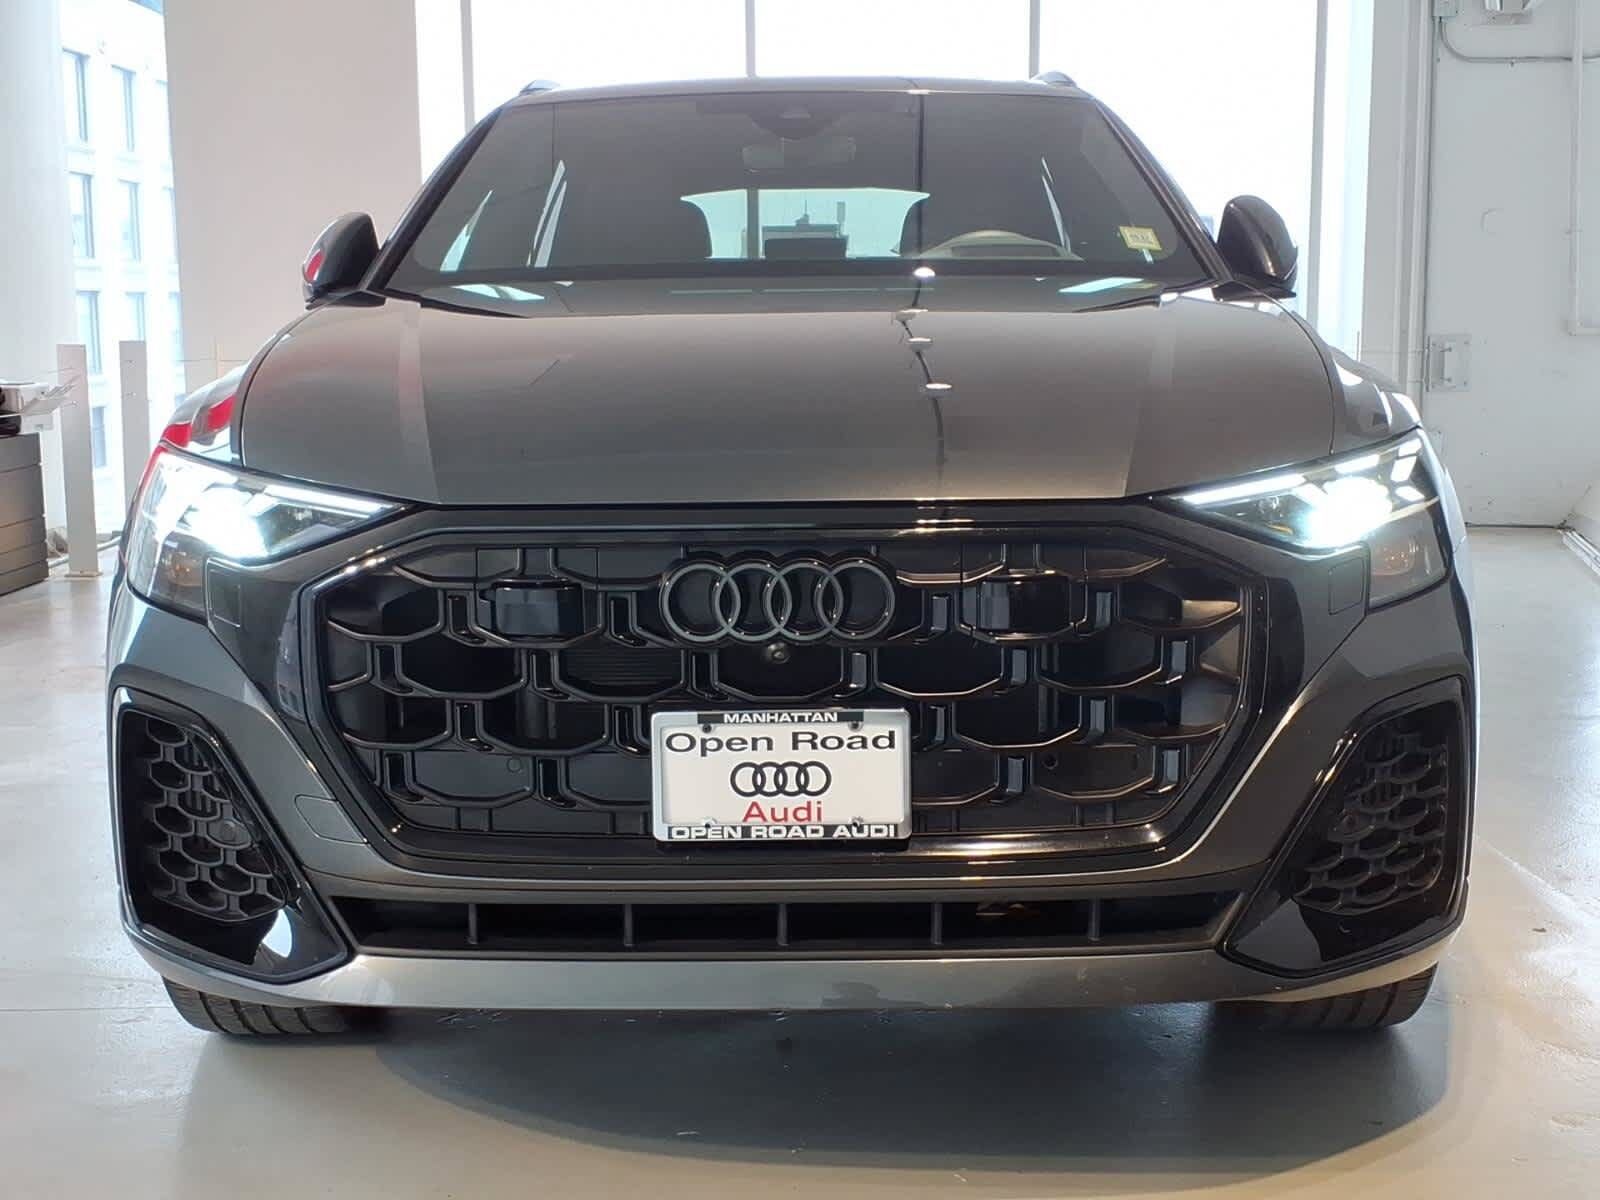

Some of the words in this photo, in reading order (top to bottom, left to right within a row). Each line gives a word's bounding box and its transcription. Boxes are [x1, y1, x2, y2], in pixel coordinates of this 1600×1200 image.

[723, 712, 838, 723] MANHATTAN
[665, 732, 773, 757] Open
[791, 730, 895, 750] Road
[742, 800, 823, 823] Audi
[671, 825, 742, 840] OPEN
[751, 825, 825, 839] ROAD
[833, 824, 895, 838] AUDI
